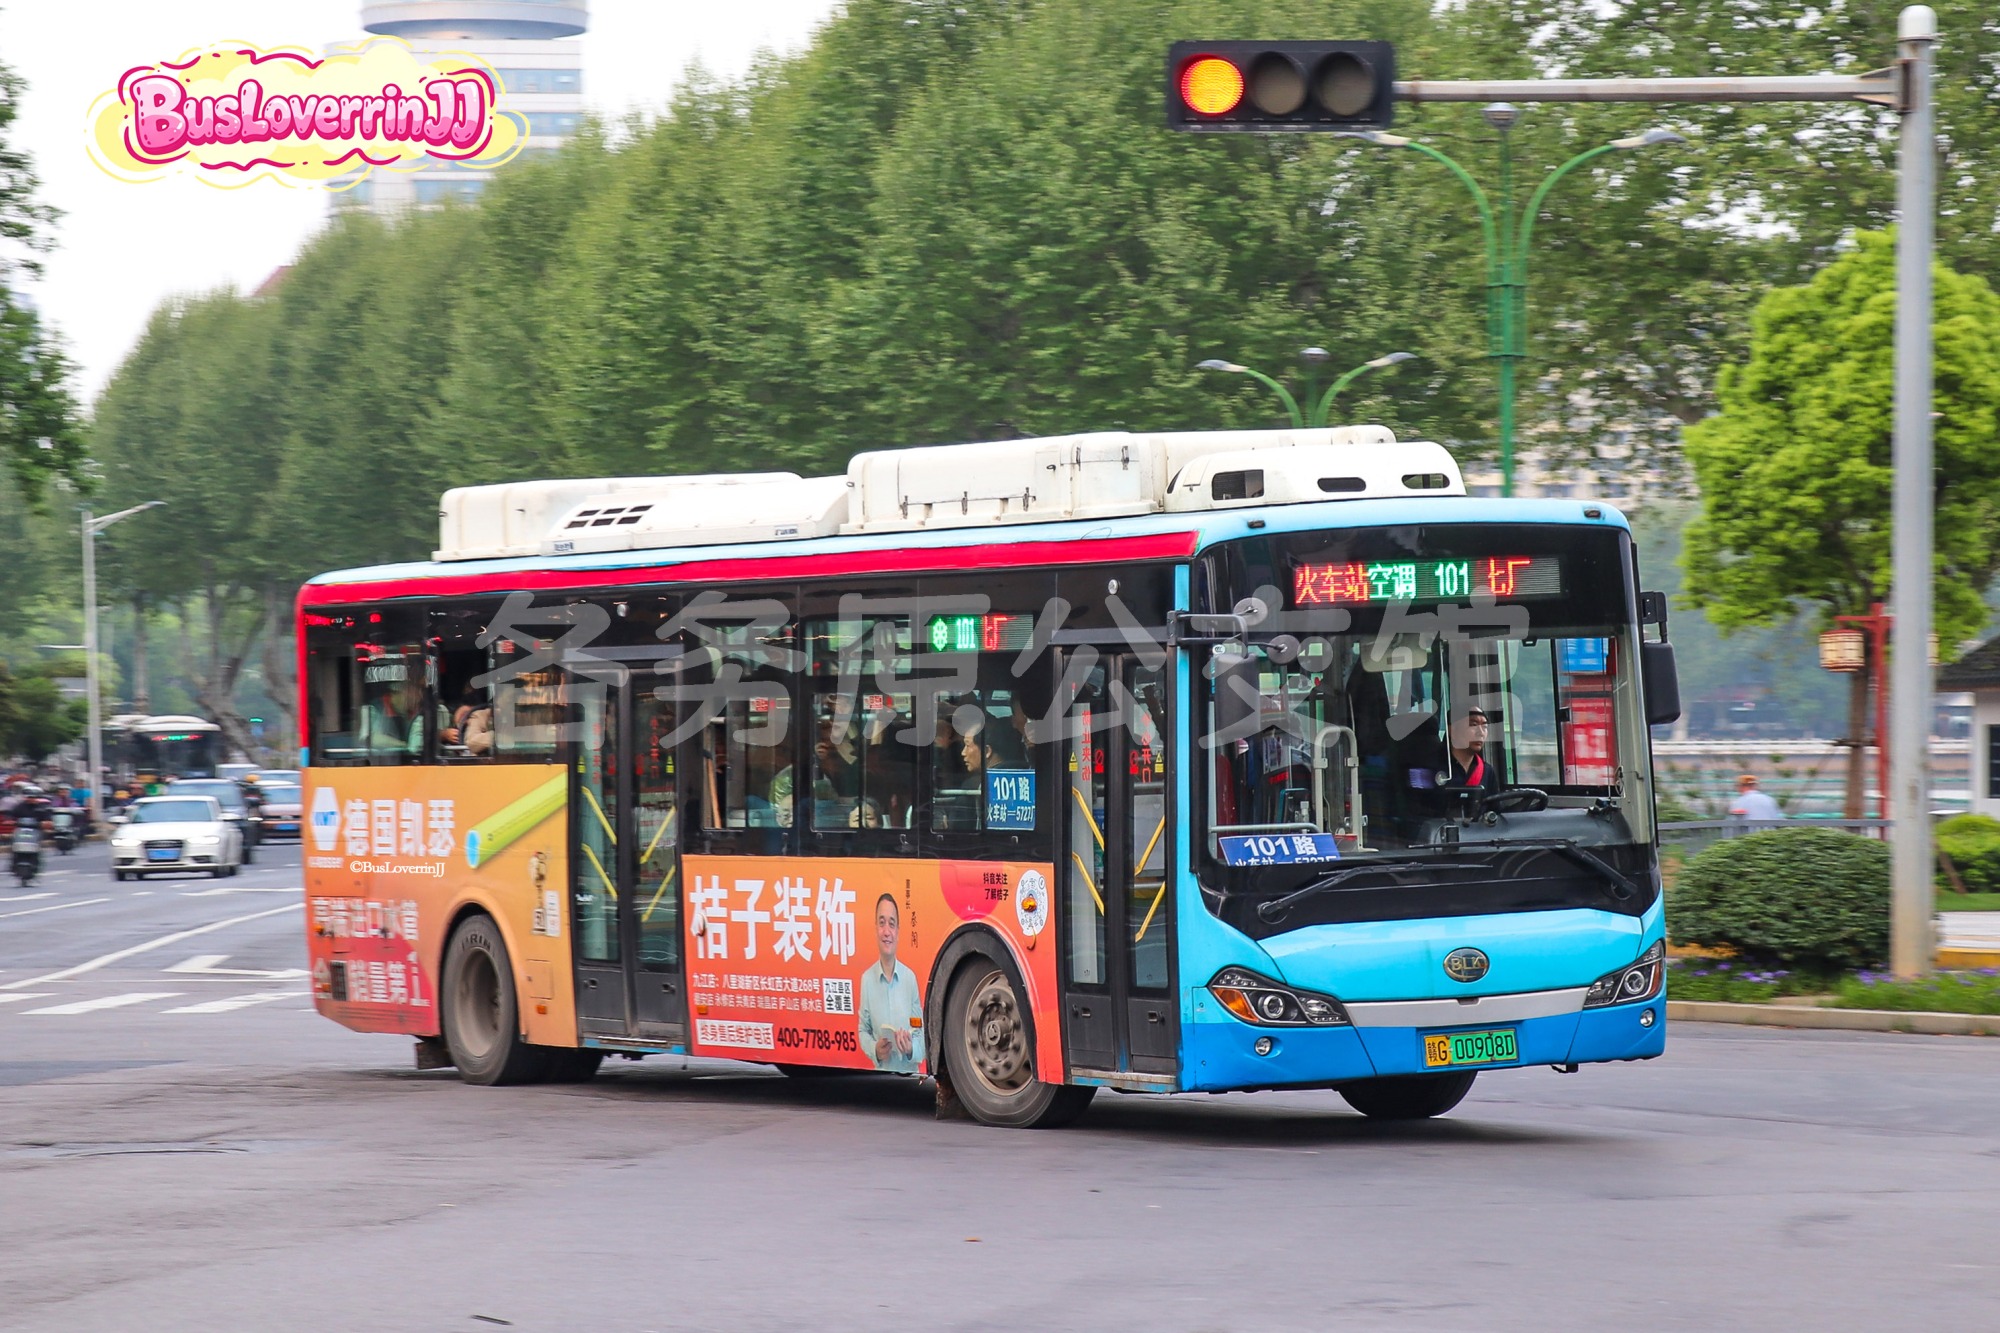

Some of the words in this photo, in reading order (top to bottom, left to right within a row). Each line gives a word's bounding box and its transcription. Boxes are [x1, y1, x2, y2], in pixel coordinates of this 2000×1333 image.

[1435, 561, 1469, 596] 101
[956, 617, 976, 649] 101
[689, 874, 857, 966] 桔子装饰
[777, 1027, 857, 1052] 400-7788-985
